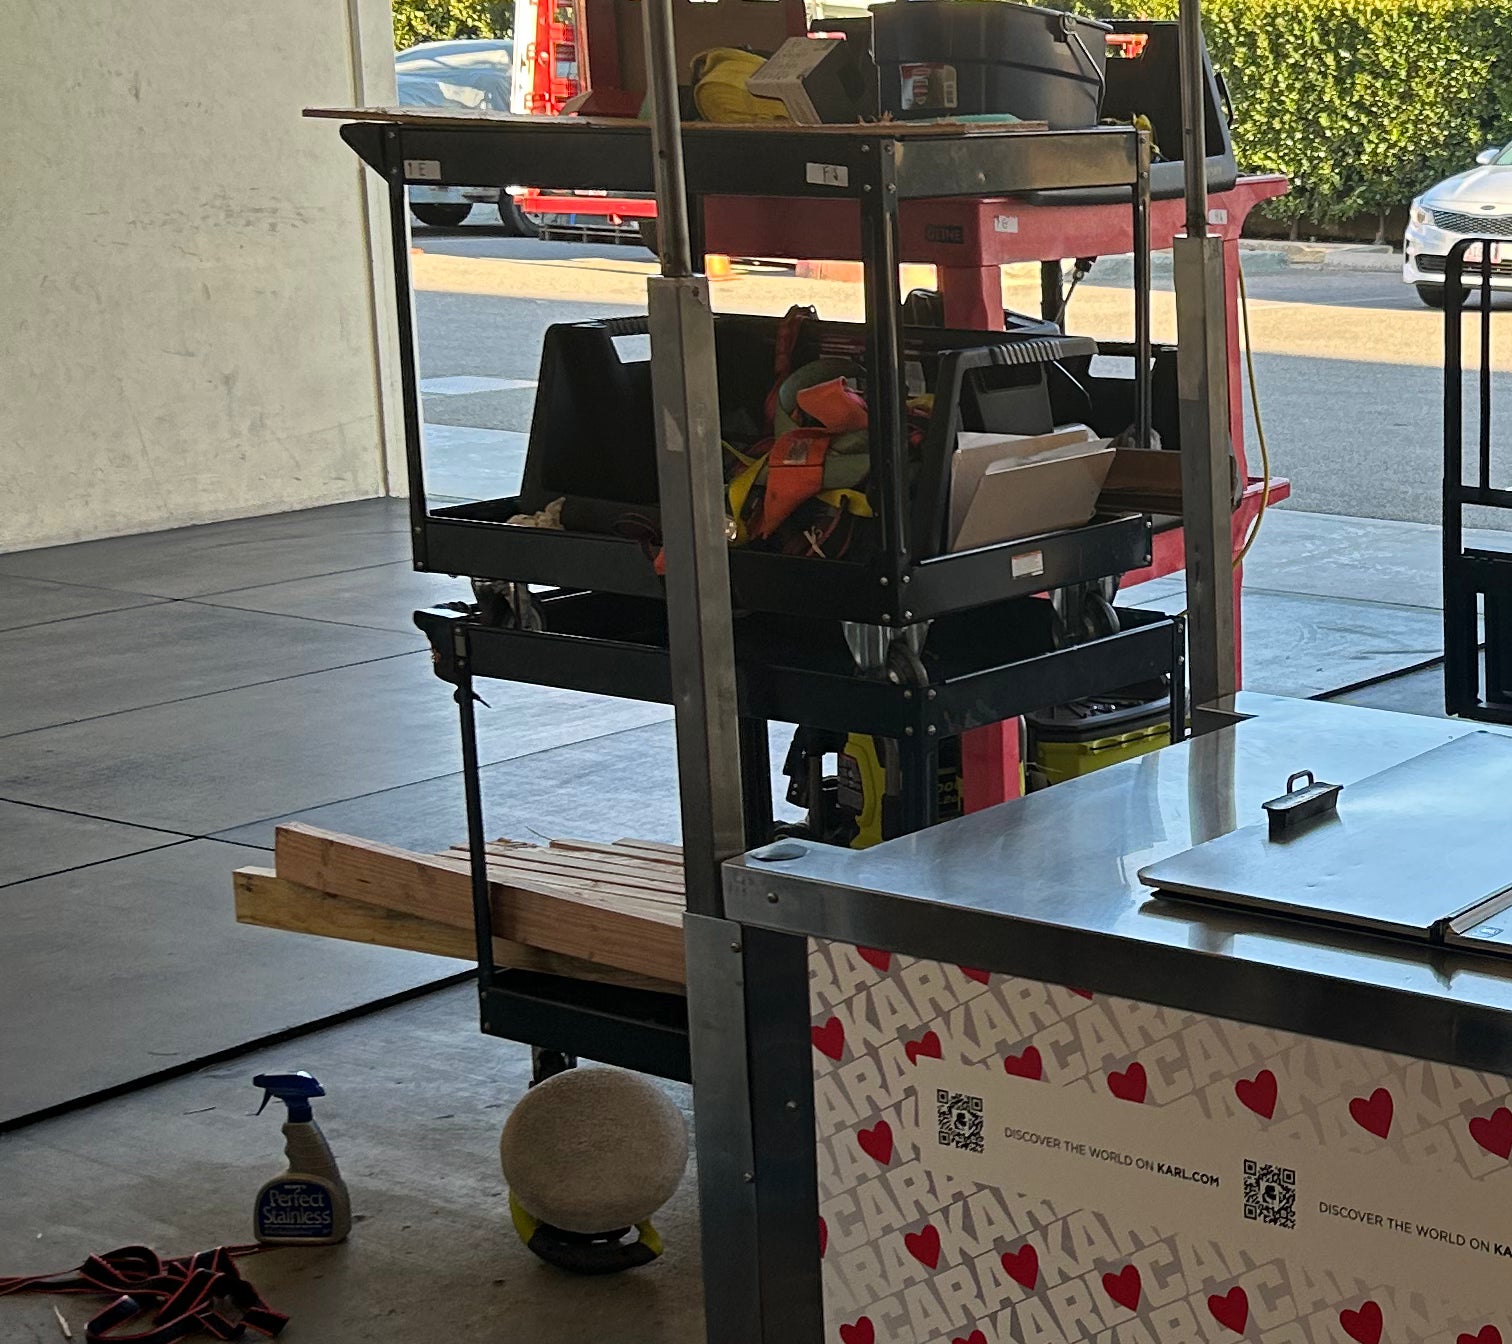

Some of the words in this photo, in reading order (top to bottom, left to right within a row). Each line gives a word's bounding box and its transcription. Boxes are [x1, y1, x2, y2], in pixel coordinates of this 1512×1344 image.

[1004, 1126, 1061, 1149] DISCOVER
[1064, 1141, 1086, 1155] THE
[1088, 1148, 1133, 1167] WORLD
[1135, 1158, 1154, 1172] ON
[1157, 1163, 1220, 1187] KARL.COM
[262, 1205, 331, 1224] Stainless
[269, 1189, 325, 1207] Perfect
[1319, 1201, 1384, 1227] DISCOVER
[1387, 1217, 1412, 1234] THE
[1415, 1224, 1466, 1247] WORLD
[1469, 1237, 1490, 1253] ON
